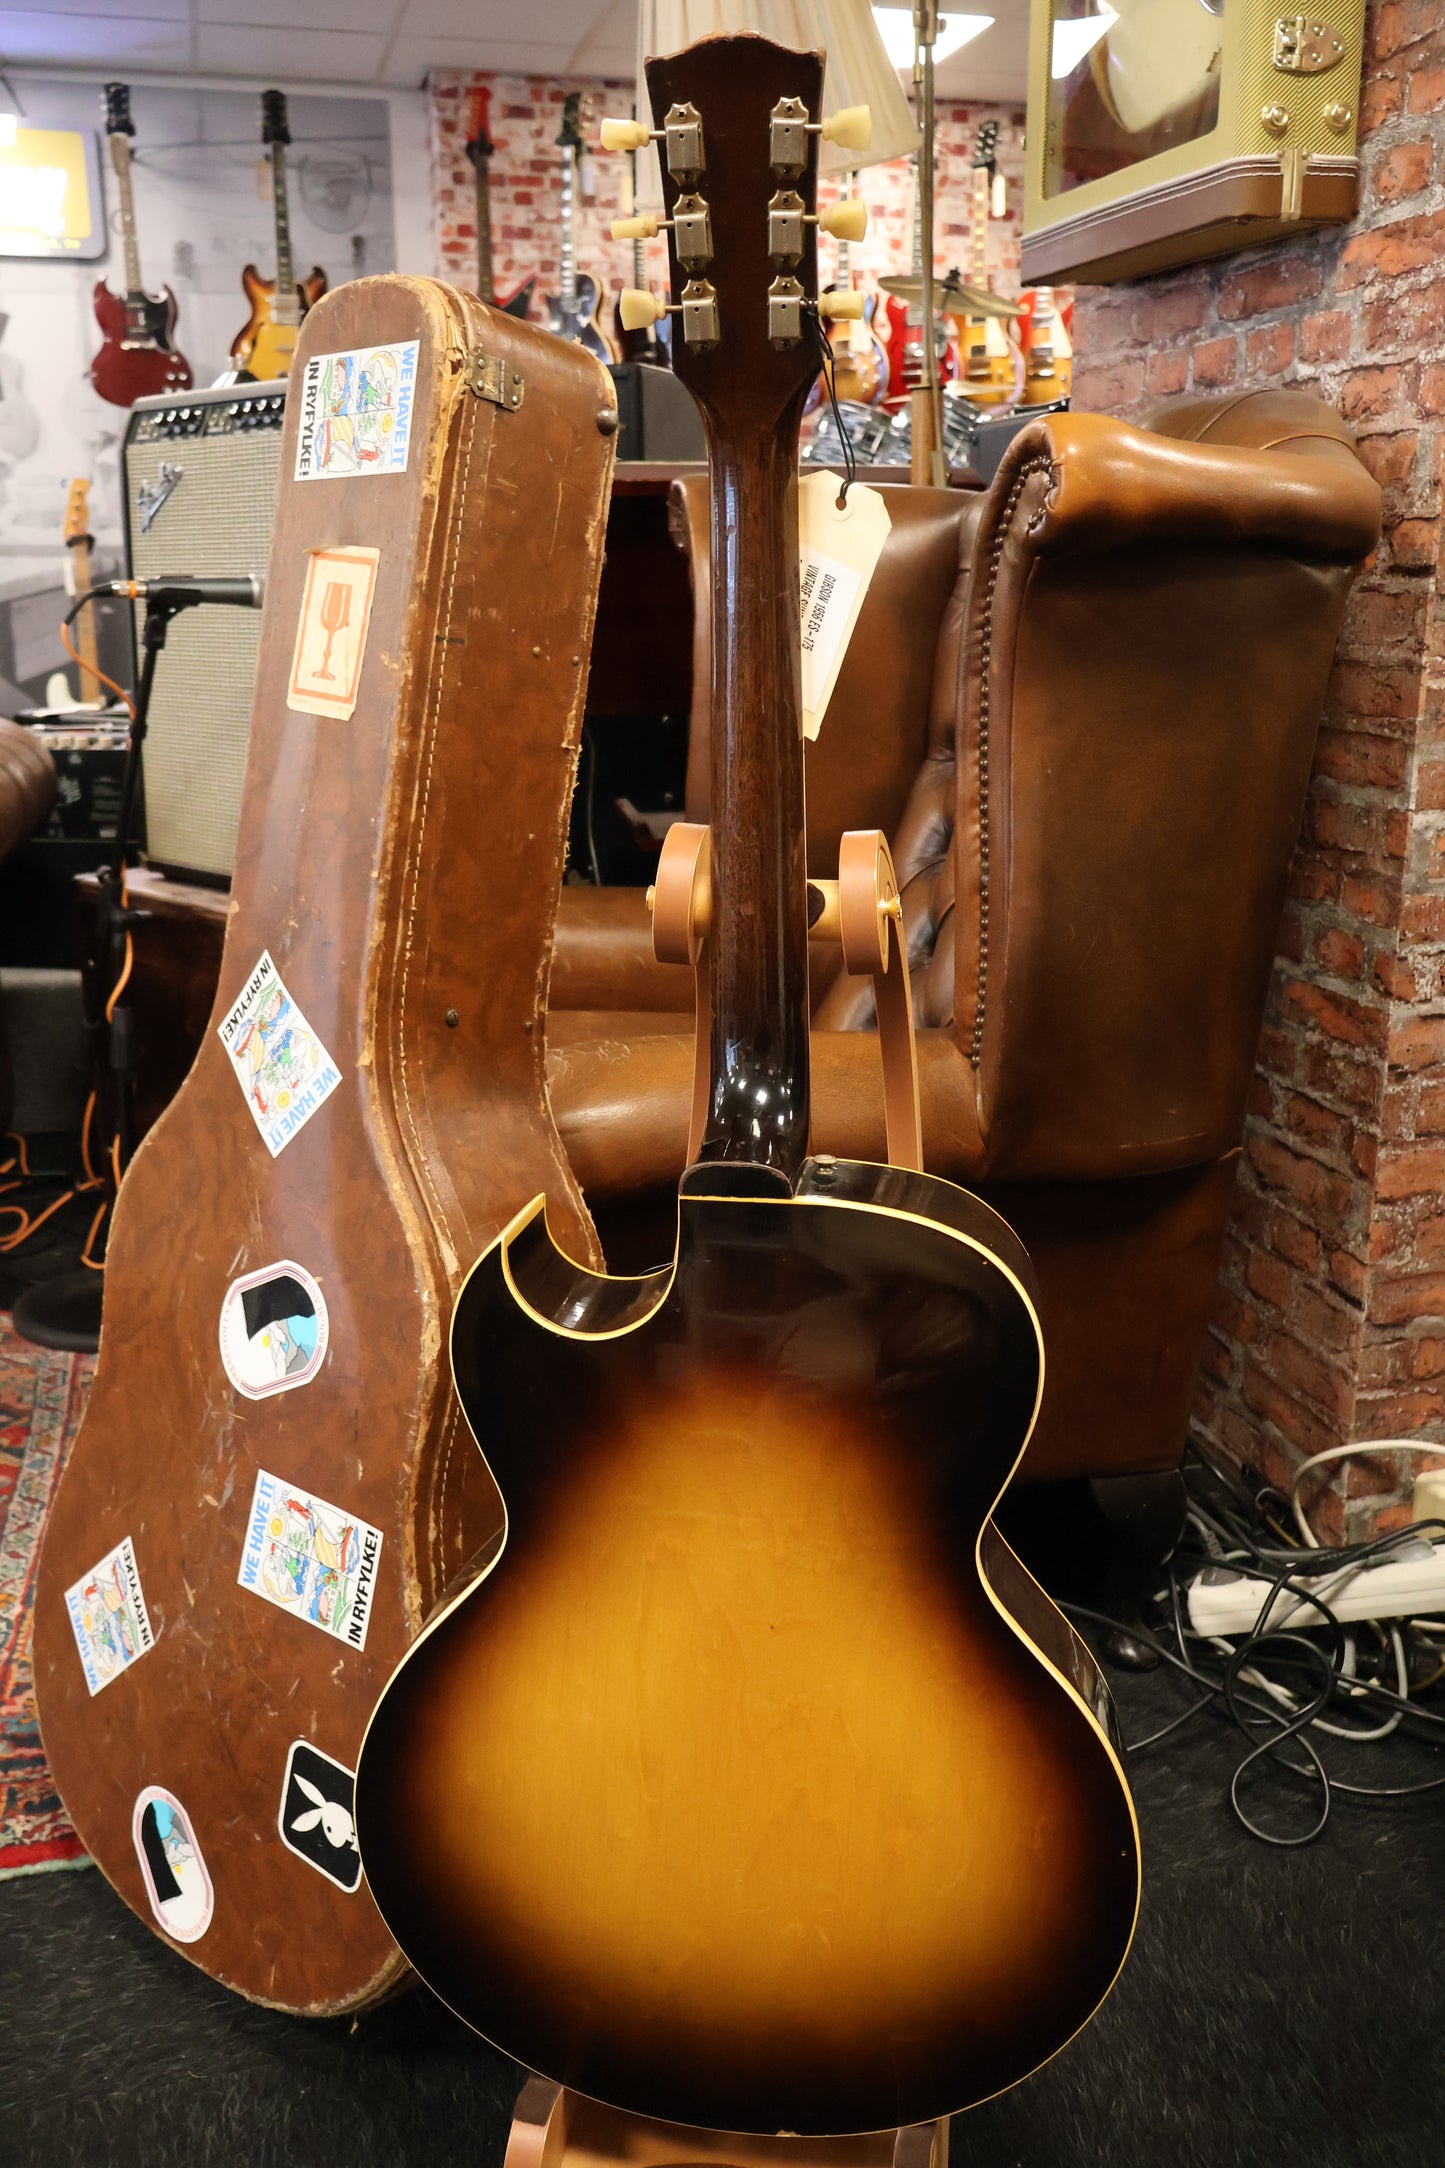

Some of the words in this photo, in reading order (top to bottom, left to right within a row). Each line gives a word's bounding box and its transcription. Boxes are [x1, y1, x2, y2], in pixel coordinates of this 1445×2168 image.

[308, 361, 320, 380] IN
[401, 346, 416, 381] WE
[394, 386, 411, 443] HAVE
[299, 385, 318, 476] RYFYLKE!
[391, 447, 405, 466] IT
[818, 574, 836, 604] GIBSON
[260, 958, 271, 979] IN
[222, 974, 262, 1042] RYFYLKE!
[312, 1067, 337, 1097] WE
[280, 1090, 316, 1135] HAVE
[268, 1127, 284, 1150] IT
[261, 1477, 276, 1499] IT
[249, 1503, 271, 1553] HAVE
[243, 1553, 260, 1585] WE
[352, 1530, 379, 1622] RYFYLKE!
[68, 1594, 79, 1611] IT
[73, 1615, 90, 1659] HAVE
[141, 1627, 151, 1646] IN
[348, 1622, 363, 1644] IN
[86, 1661, 98, 1690] WE
